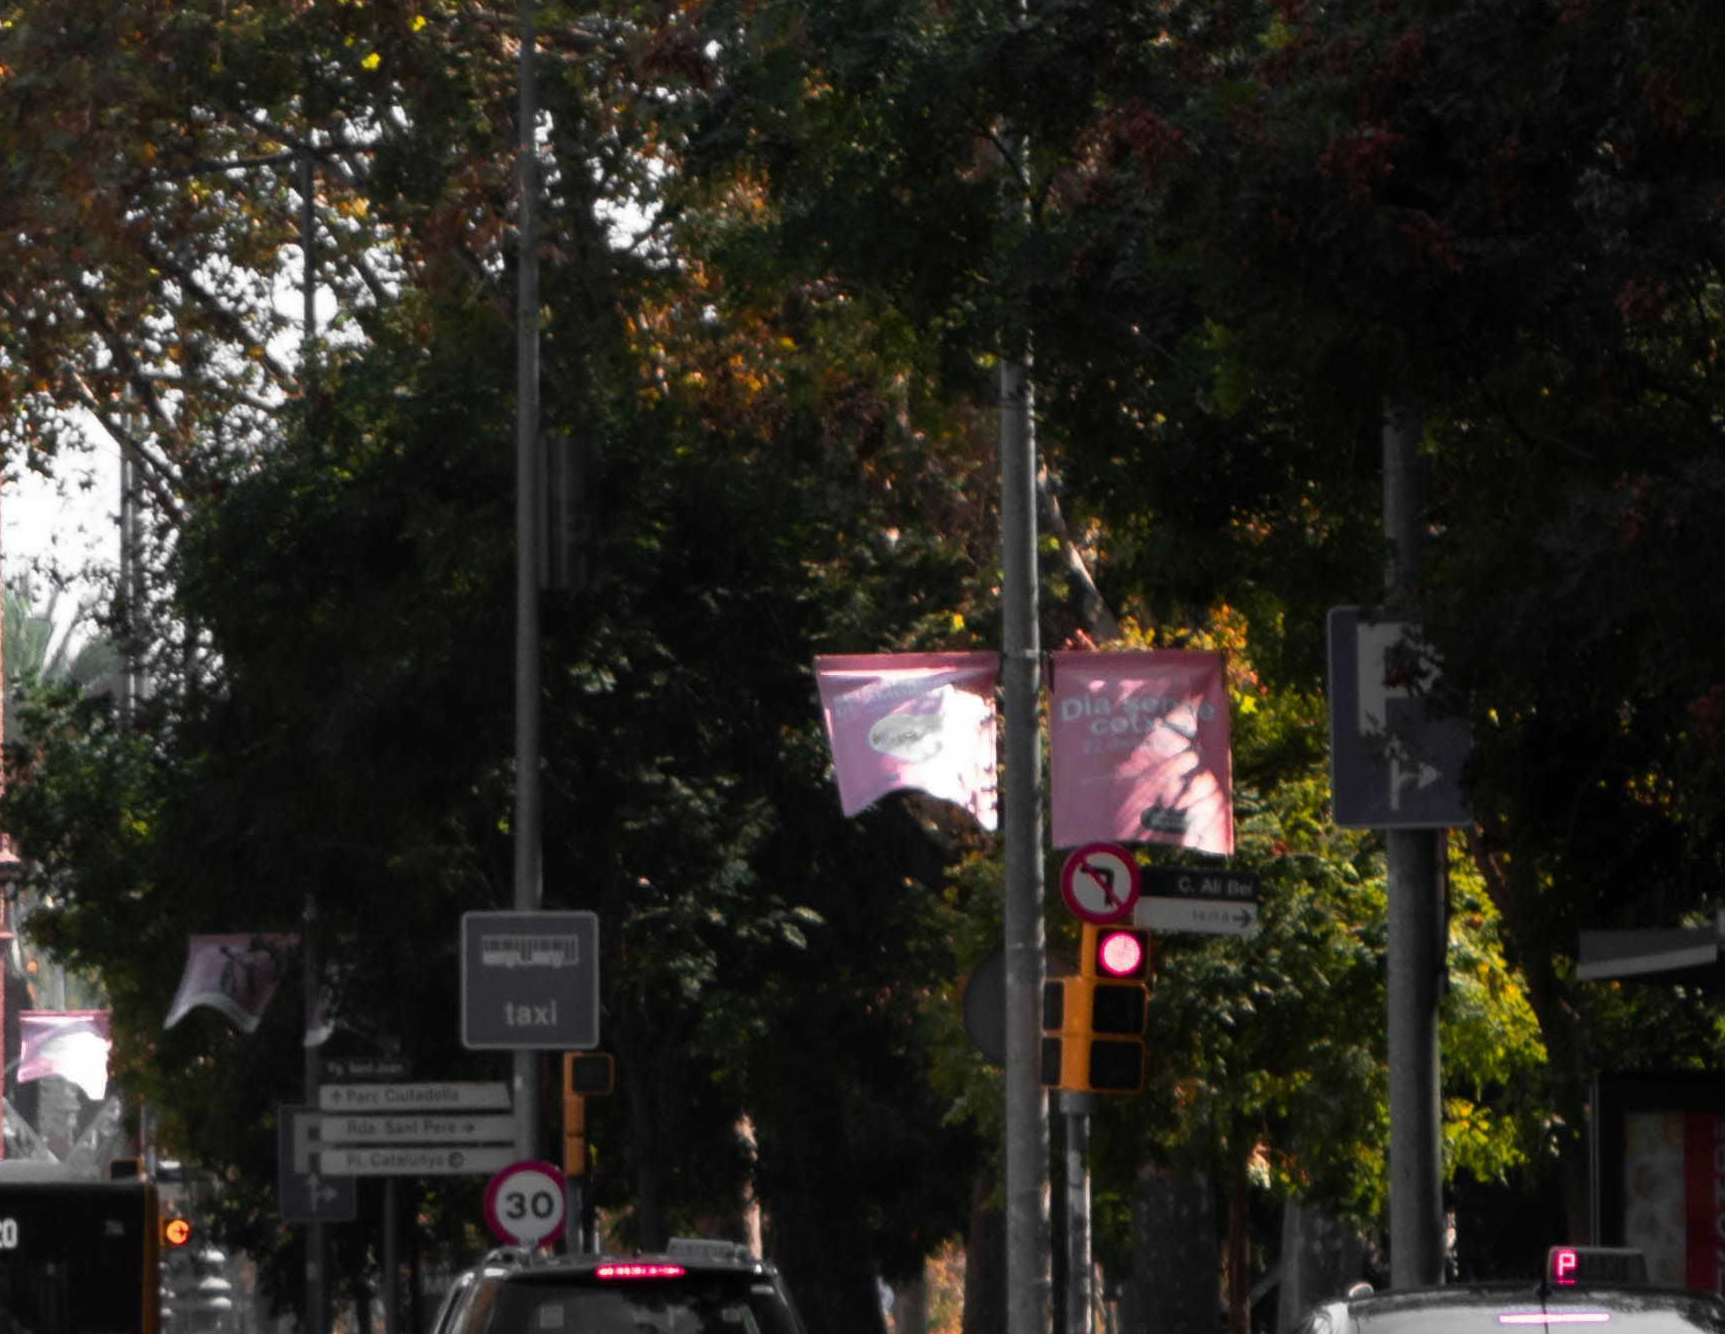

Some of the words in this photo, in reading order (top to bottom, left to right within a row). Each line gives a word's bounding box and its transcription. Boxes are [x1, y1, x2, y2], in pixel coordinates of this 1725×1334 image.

[1062, 694, 1111, 723] Dia
[1178, 875, 1195, 893] C.
[505, 1000, 557, 1027] taxi
[346, 1089, 378, 1104] Parc
[384, 1087, 460, 1103] Ciutadella
[385, 1120, 418, 1134] Sant
[423, 1119, 457, 1134] Pere
[369, 1152, 444, 1168] Catalunya
[506, 1190, 554, 1220] 30
